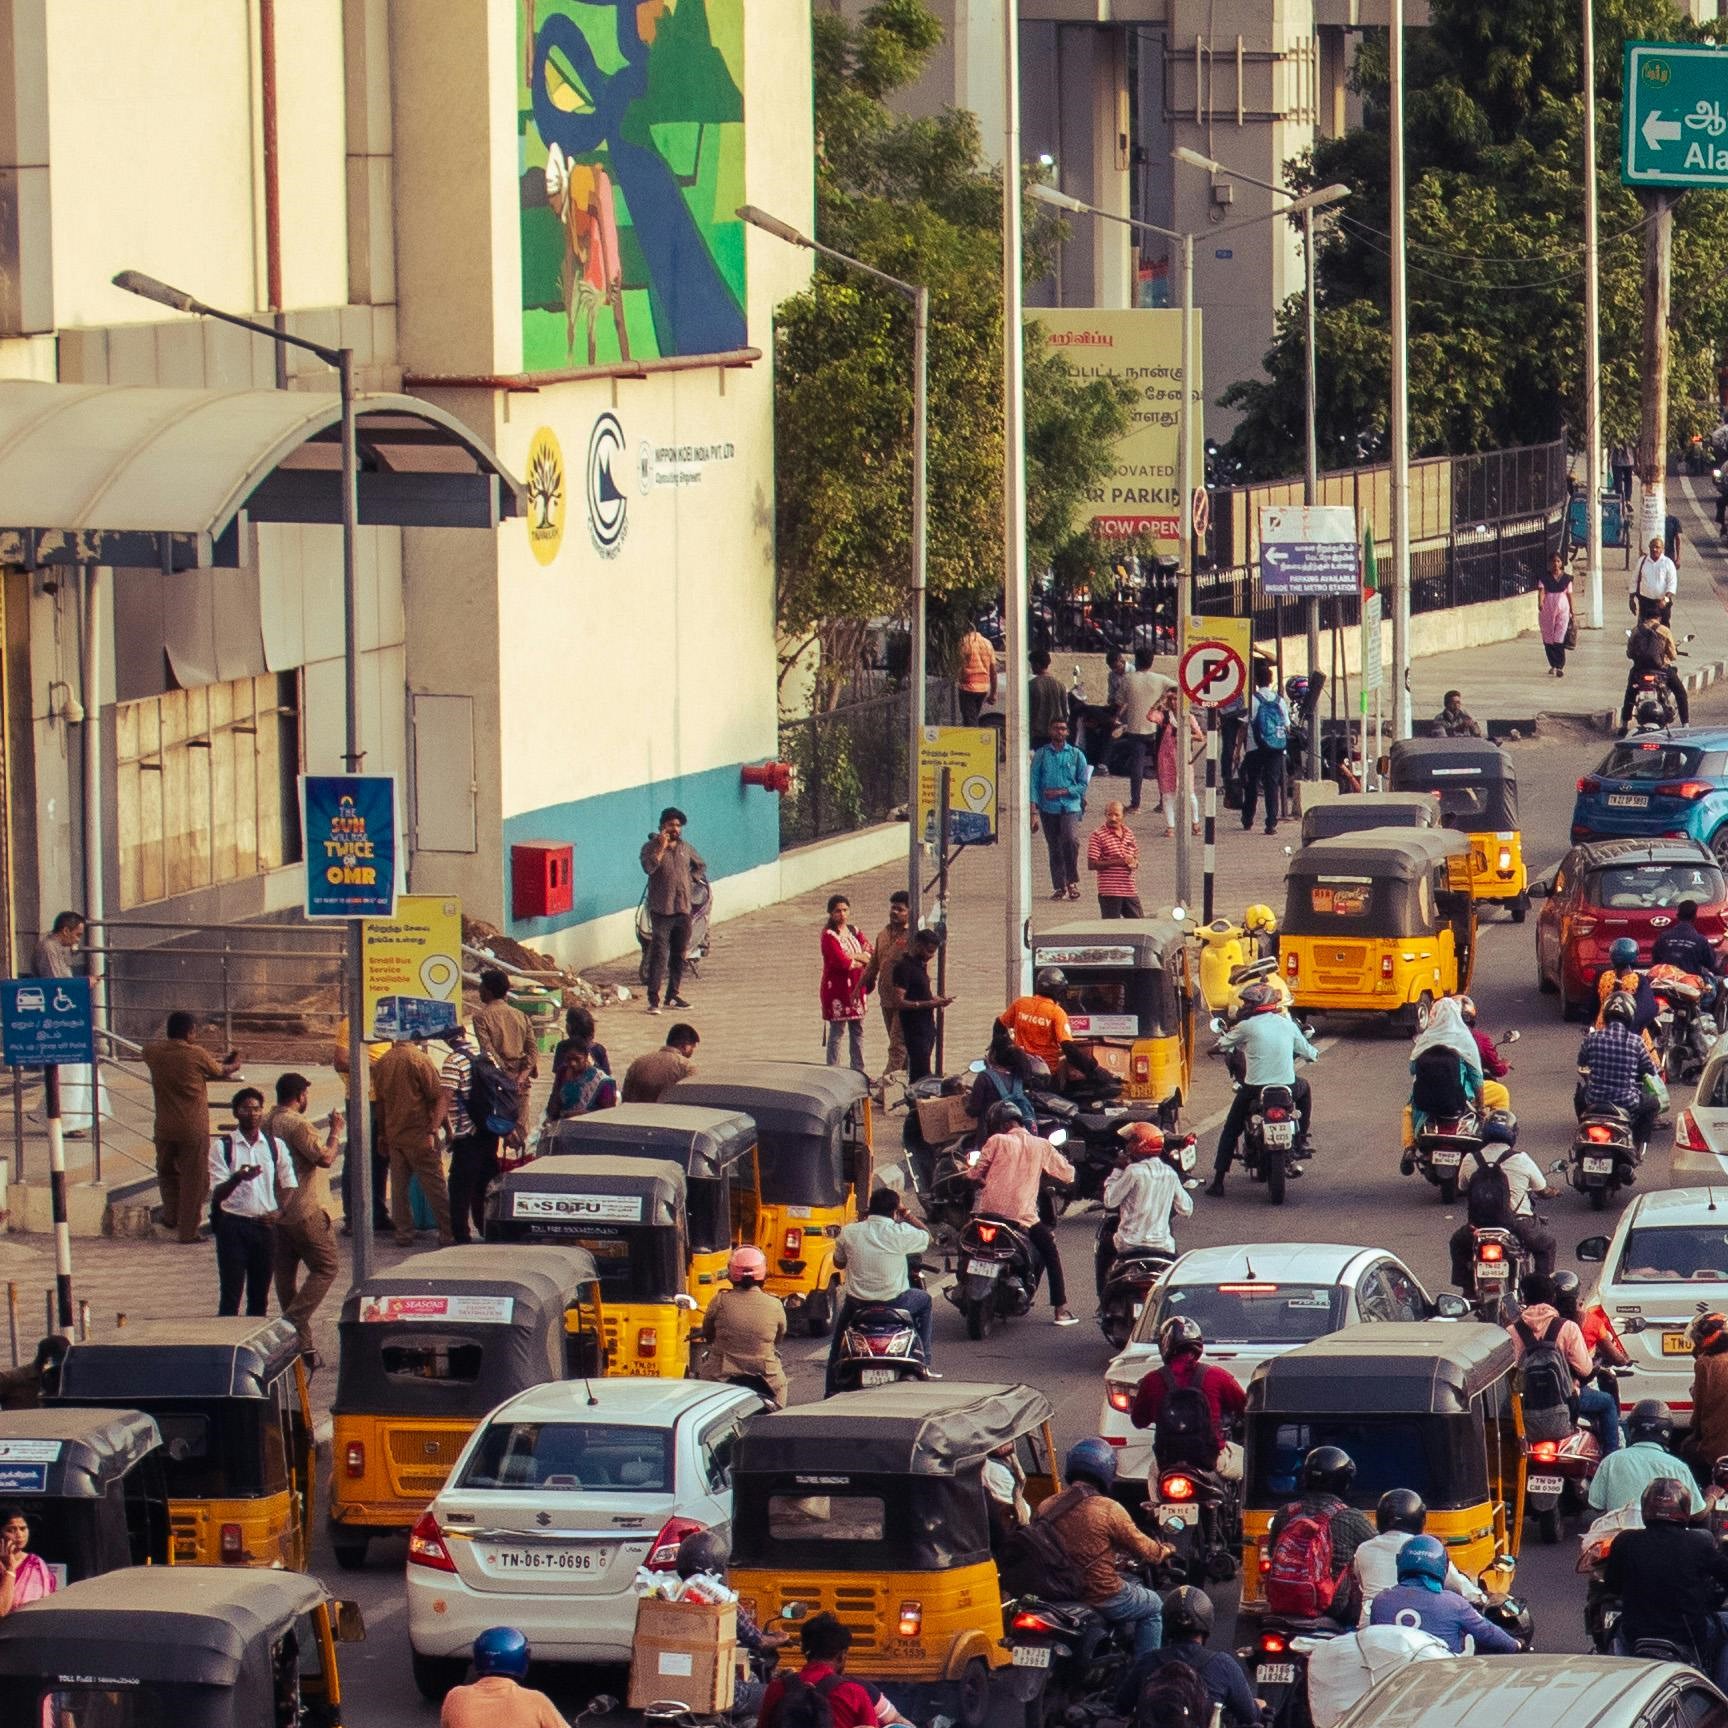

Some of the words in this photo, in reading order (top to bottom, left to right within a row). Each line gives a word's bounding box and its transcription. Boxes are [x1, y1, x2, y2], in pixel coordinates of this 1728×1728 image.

[1147, 521, 1181, 537] OPEN
[1265, 584, 1288, 592] INSIDE
[1304, 585, 1328, 593] METRO
[1329, 585, 1357, 593] STATION
[331, 817, 366, 835] SUN
[324, 843, 375, 859] TWICE
[326, 866, 376, 886] OMR
[369, 956, 399, 966] Small
[401, 956, 414, 966] Bus
[369, 965, 402, 975] Service
[369, 975, 412, 985] Available
[369, 984, 391, 993] Here
[501, 1553, 591, 1569] TN-06-T-0696
